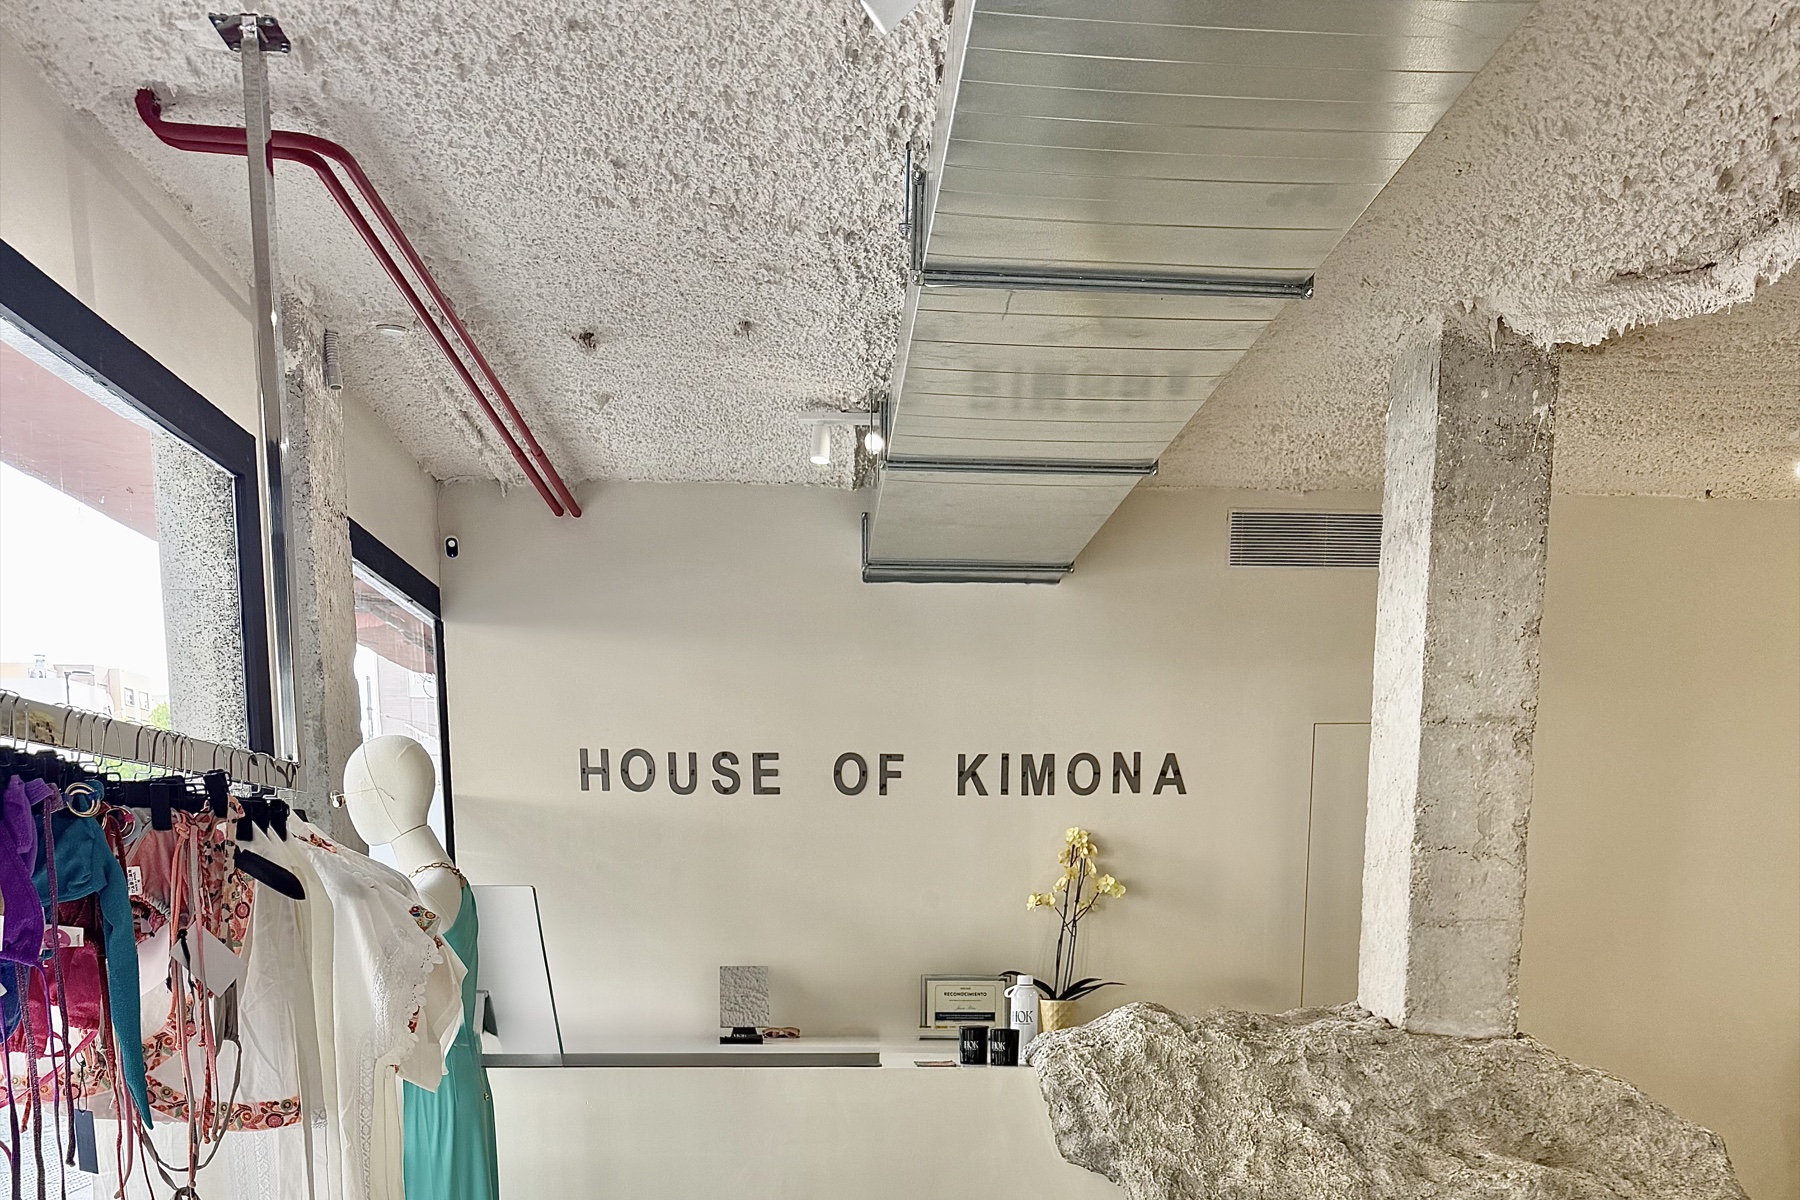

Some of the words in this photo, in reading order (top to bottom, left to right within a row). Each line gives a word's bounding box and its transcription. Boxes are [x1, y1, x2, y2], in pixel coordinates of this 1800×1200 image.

[579, 748, 781, 796] HOUSE
[833, 751, 905, 797] OF
[957, 751, 1188, 797] KIMONA
[1012, 1010, 1034, 1023] HOK
